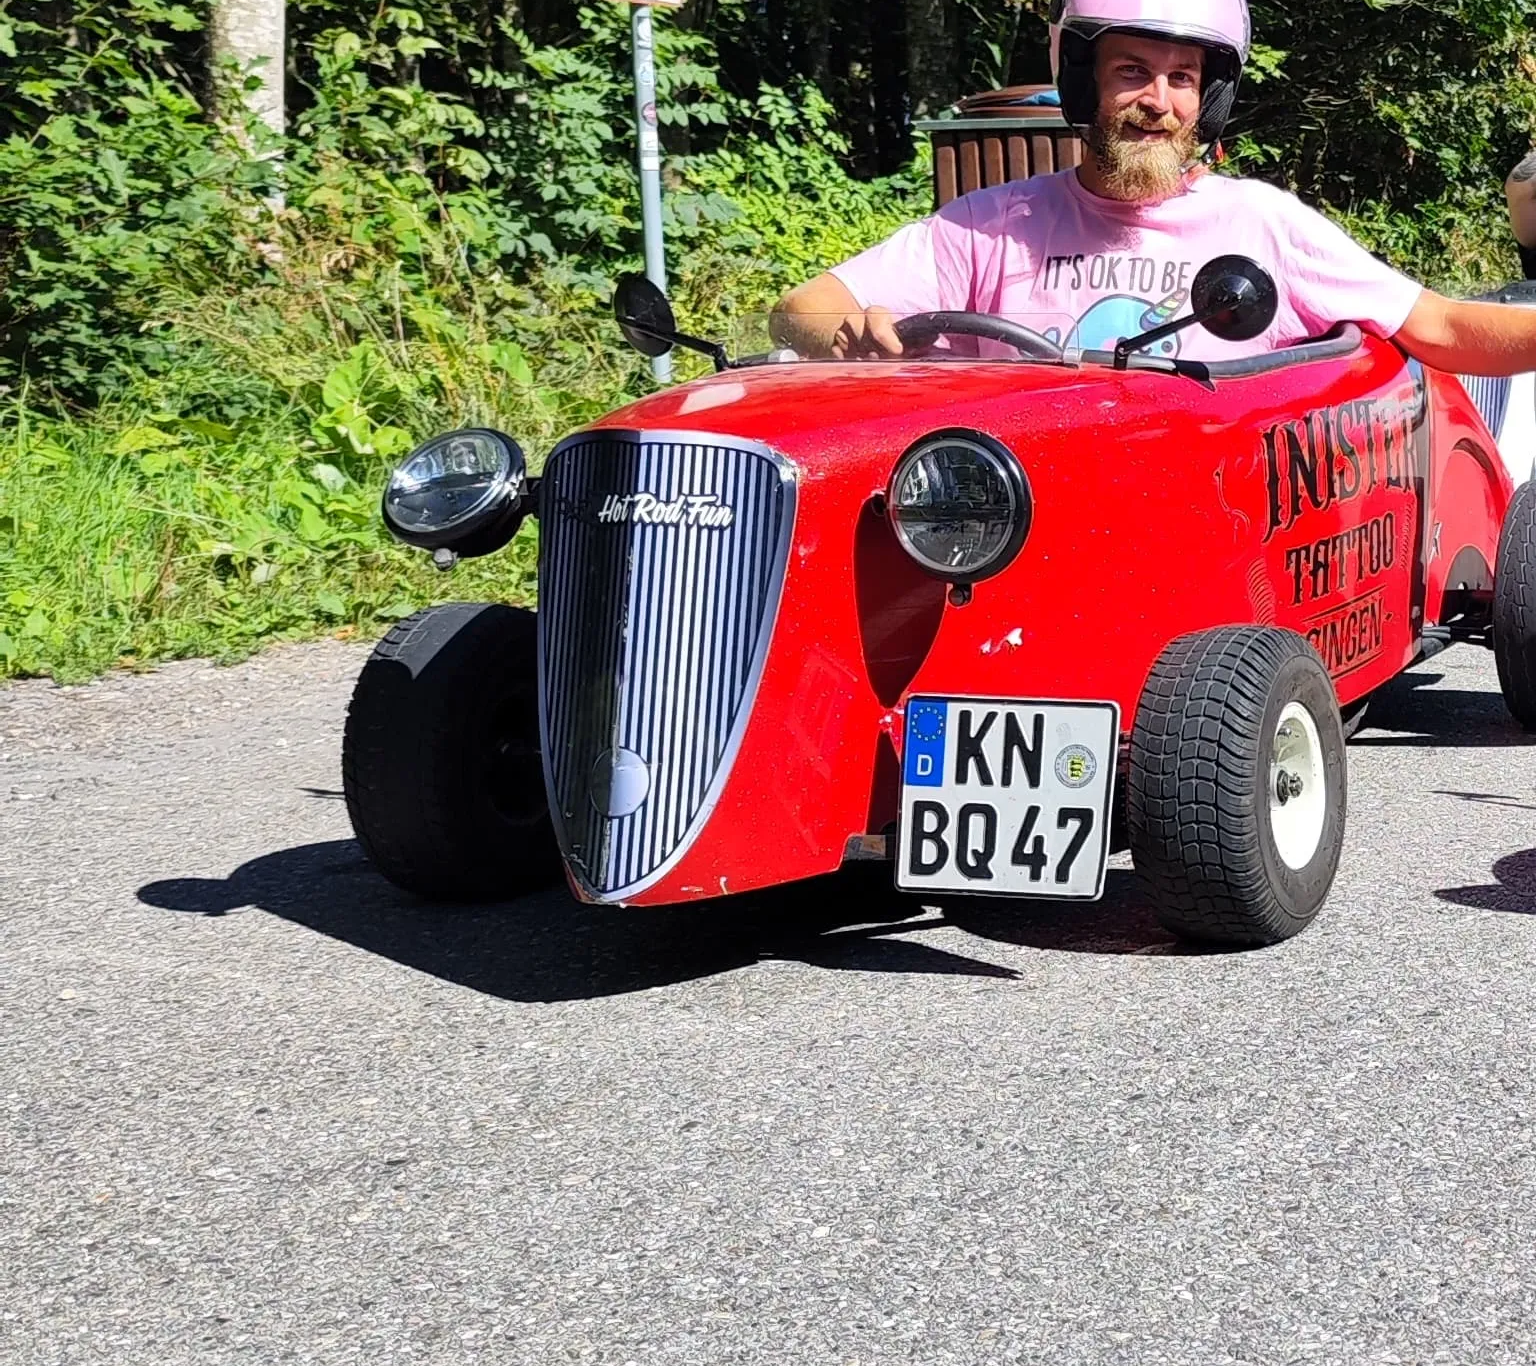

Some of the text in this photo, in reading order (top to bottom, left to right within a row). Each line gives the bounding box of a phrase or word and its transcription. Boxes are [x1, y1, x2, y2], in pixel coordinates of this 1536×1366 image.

[1043, 253, 1192, 293] IT'S OK TO BE
[598, 492, 734, 527] Hot Rod Fun
[1285, 511, 1395, 607] TATTOO
[916, 754, 933, 776] D
[955, 709, 1045, 788] KN
[909, 800, 1095, 884] BQ 47
